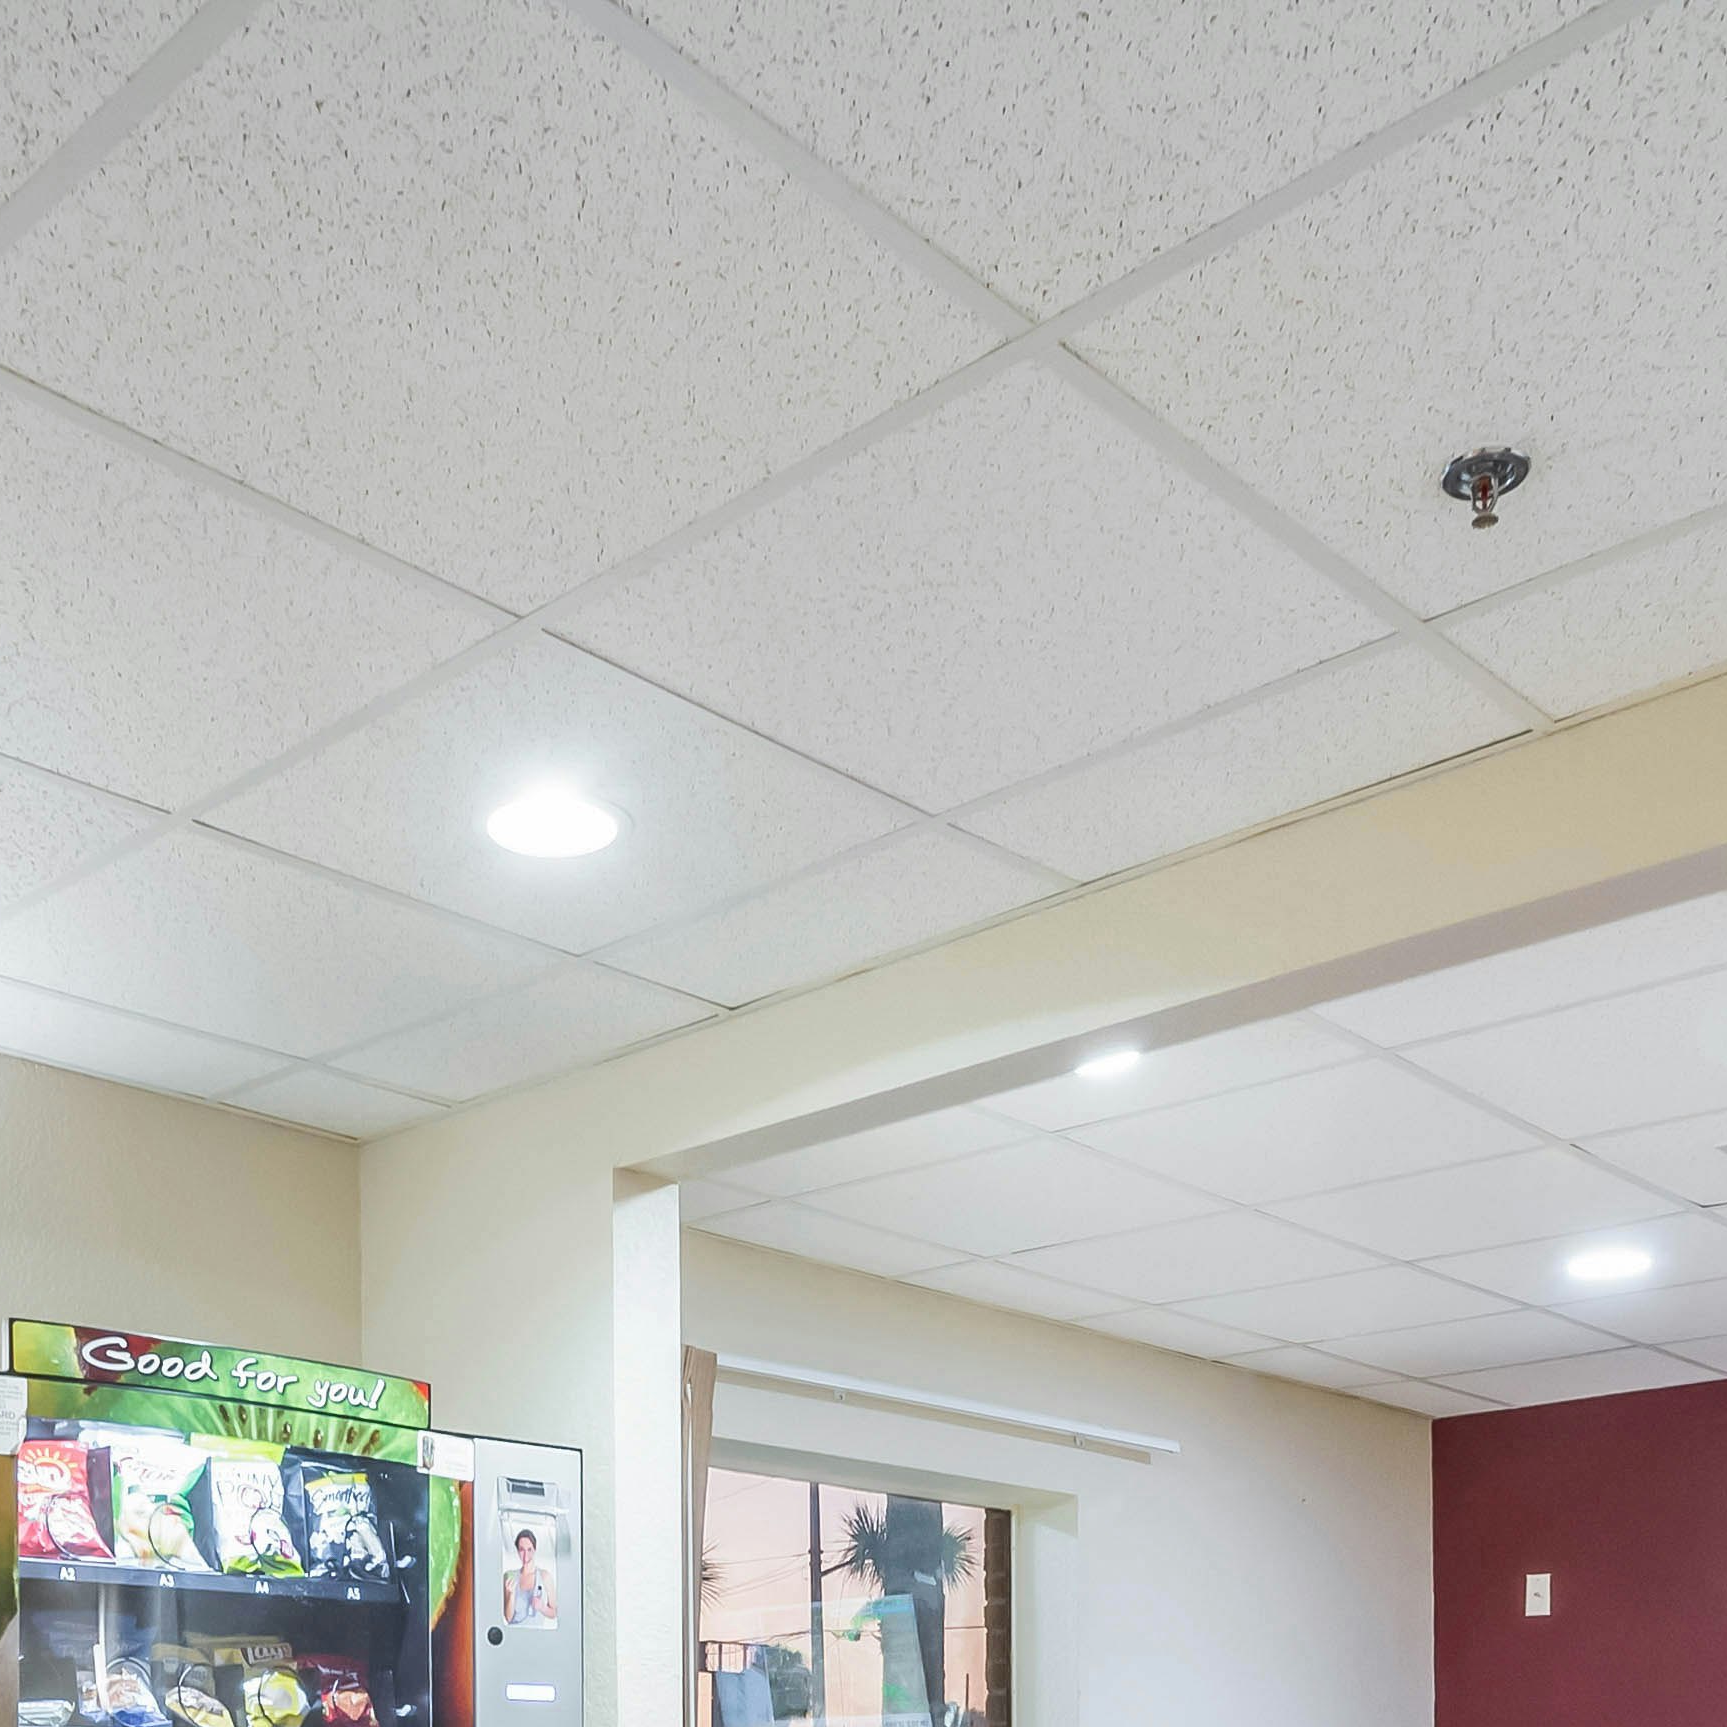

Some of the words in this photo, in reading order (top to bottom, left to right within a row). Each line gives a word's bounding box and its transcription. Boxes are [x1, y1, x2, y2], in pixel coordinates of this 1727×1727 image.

[81, 1336, 218, 1382] Good
[232, 1357, 298, 1393] for
[307, 1378, 385, 1410] you!
